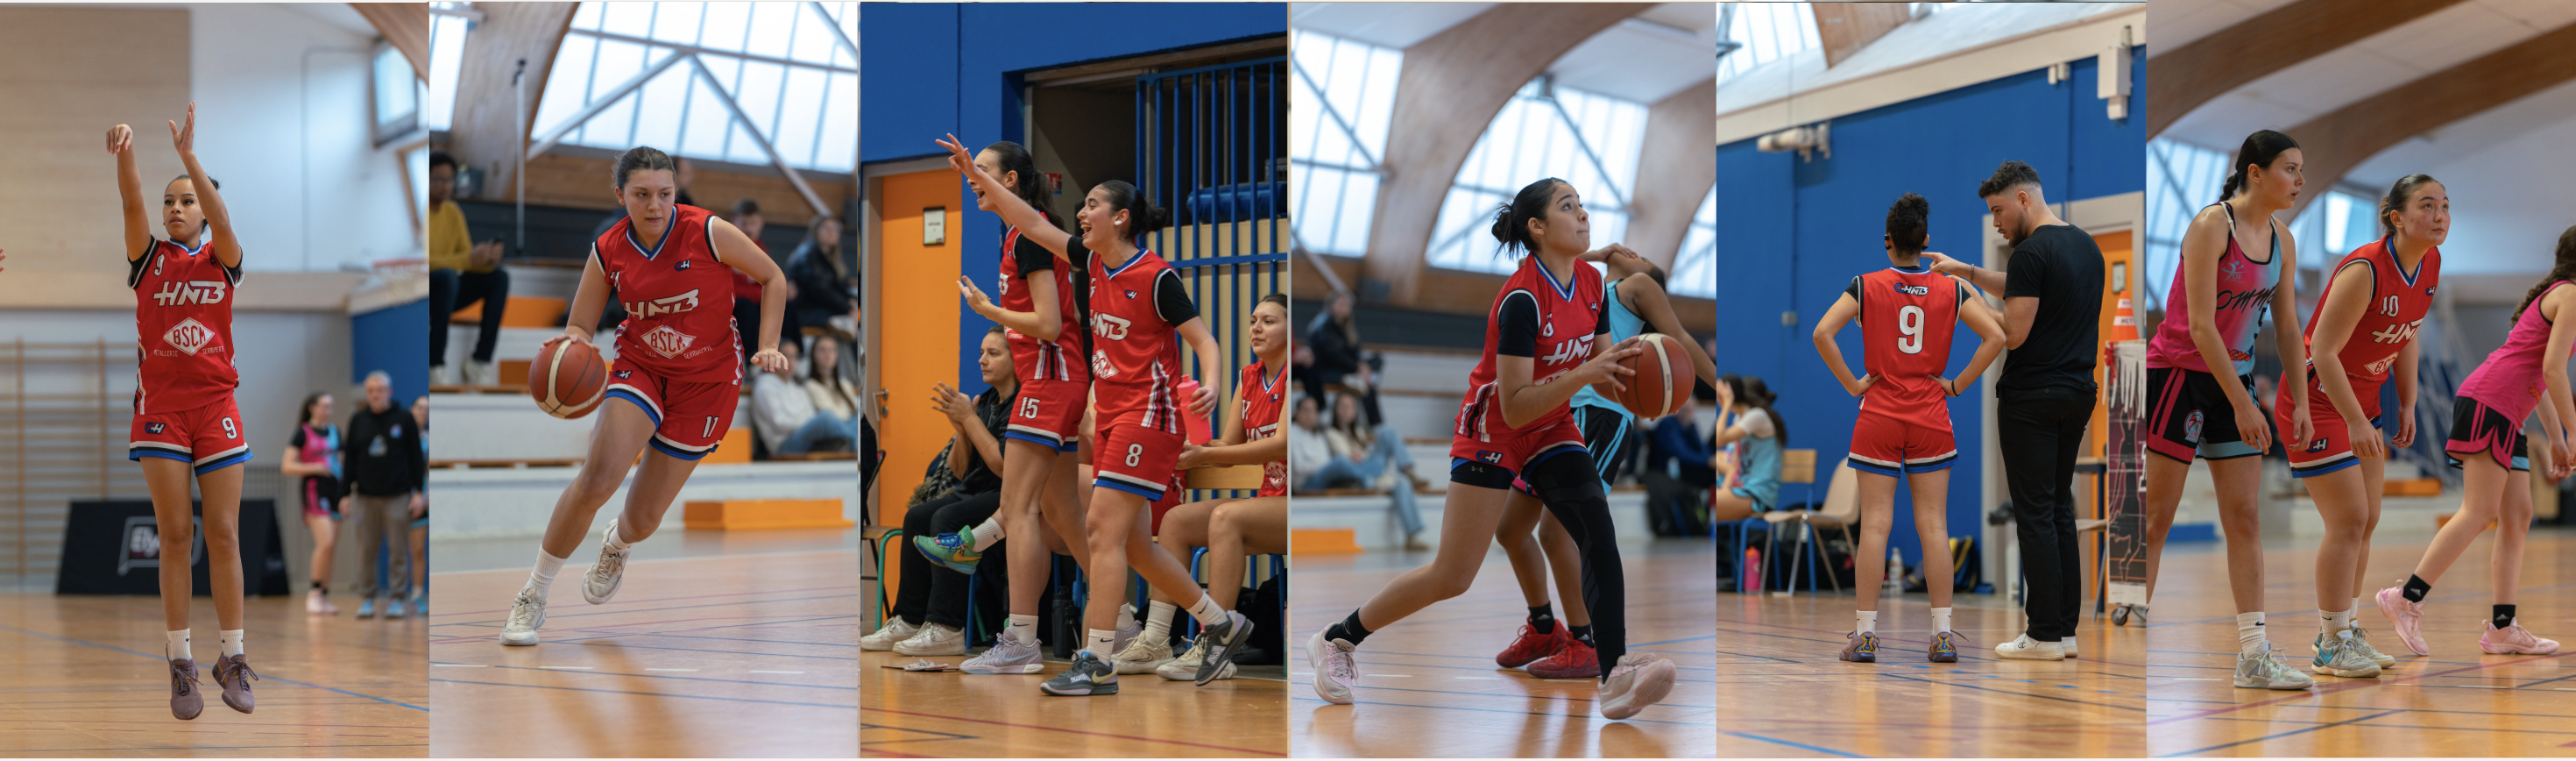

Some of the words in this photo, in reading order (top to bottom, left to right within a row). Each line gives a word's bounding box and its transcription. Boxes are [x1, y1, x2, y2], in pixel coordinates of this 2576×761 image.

[154, 253, 166, 276] 9
[152, 280, 226, 307] HNB
[2379, 294, 2400, 317] 10
[173, 324, 206, 348] BSCM
[650, 330, 687, 353] BSCM
[1897, 304, 1925, 355] 9
[1018, 396, 1041, 420] 15
[221, 416, 237, 440] 9
[702, 415, 719, 438] 11
[1124, 443, 1143, 467] 8
